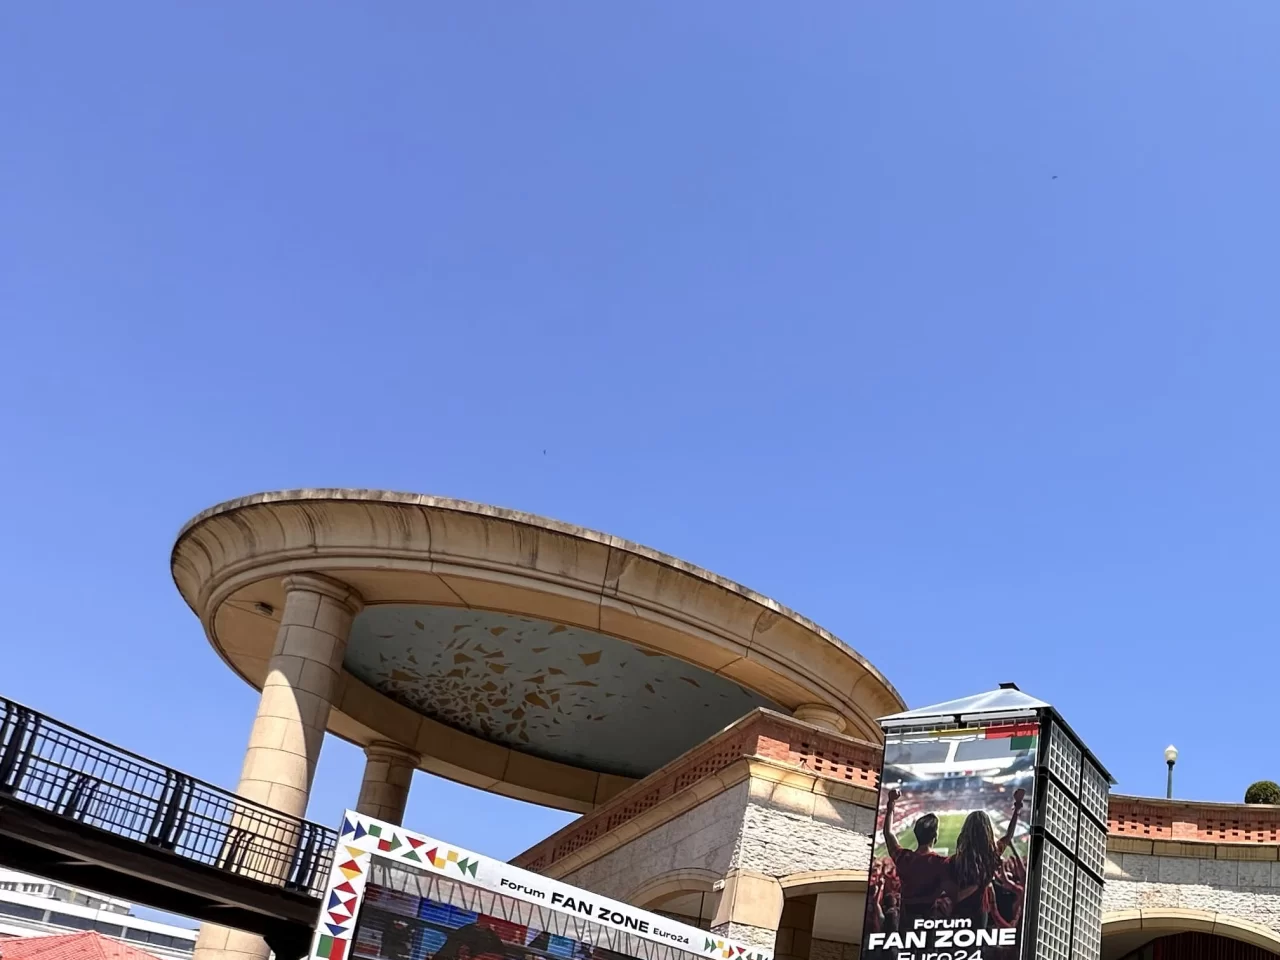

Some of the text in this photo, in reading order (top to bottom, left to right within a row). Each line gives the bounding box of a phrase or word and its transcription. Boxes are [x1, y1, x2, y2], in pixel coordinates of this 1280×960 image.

[500, 878, 689, 945] Forum FAN ZONE Euro24
[913, 918, 972, 931] Forum
[868, 928, 1017, 950] FAN ZONE
